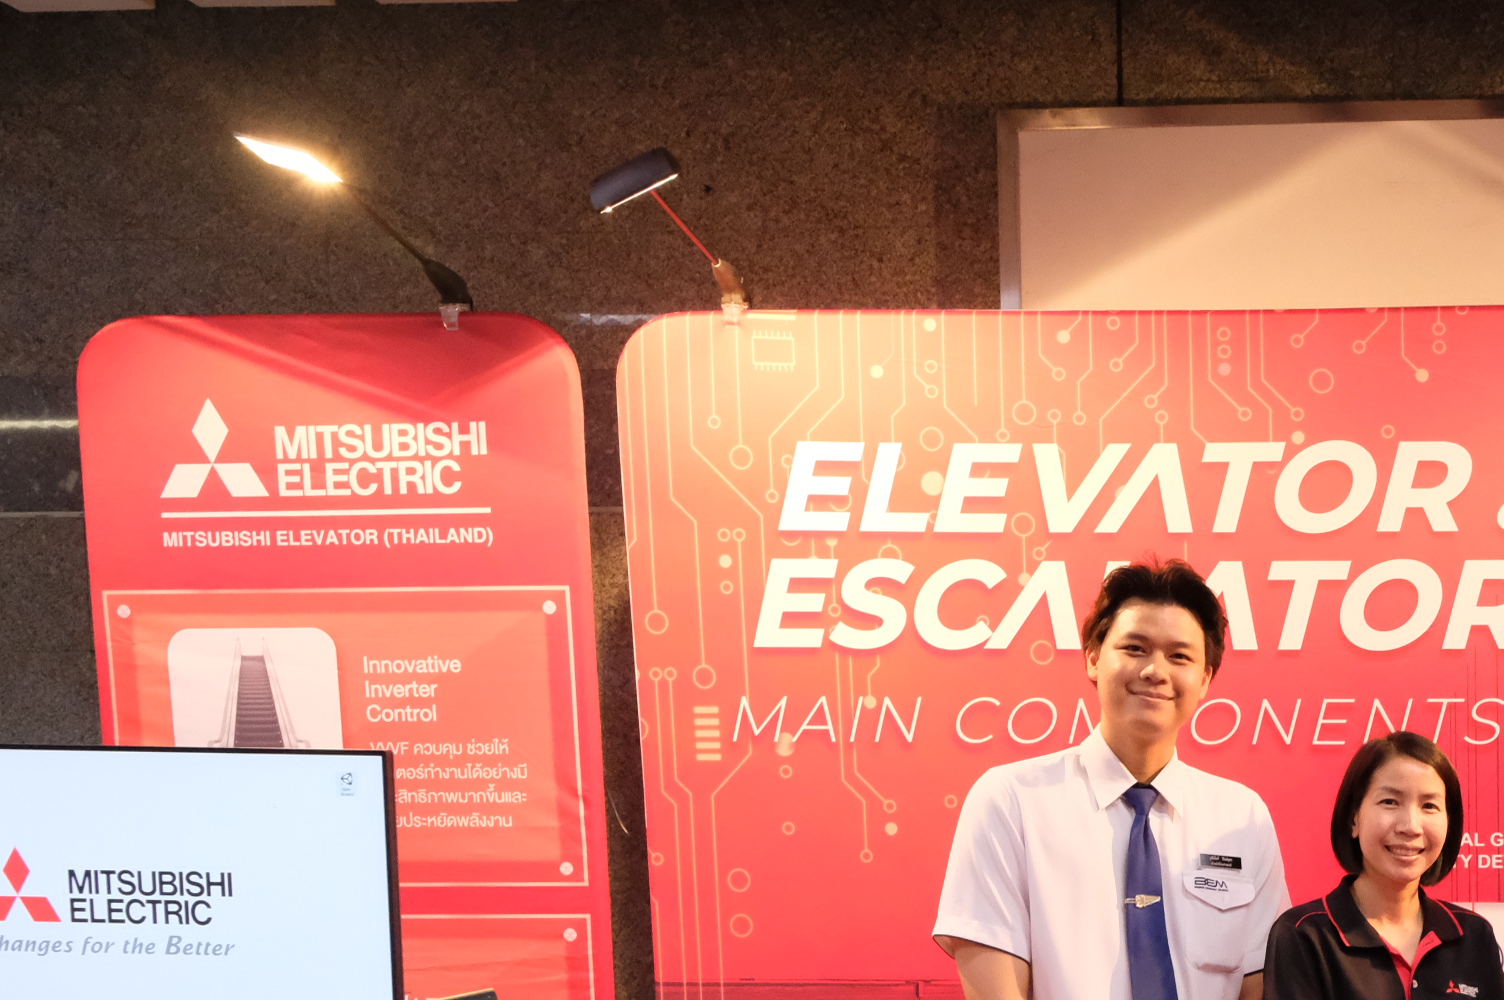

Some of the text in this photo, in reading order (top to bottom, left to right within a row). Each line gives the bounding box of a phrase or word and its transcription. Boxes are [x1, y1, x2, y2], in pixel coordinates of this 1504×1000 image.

[274, 421, 488, 459] MITSUBISHI
[278, 460, 462, 497] ELECTRIC
[776, 439, 1474, 534] ELEVATOR
[163, 526, 493, 548] MITSUBISHI ELEVATOR (THAILAND)
[363, 655, 462, 673] Innovative
[365, 681, 438, 698] Inverter
[366, 704, 437, 723] Control
[732, 695, 923, 745] MAIN
[414, 743, 462, 759] ควบคุม
[466, 738, 509, 755] ช่วยให้
[396, 763, 528, 779] ตอร์ทำงานได้อย่างมี
[395, 784, 527, 803] ะสิทธิภาพมากขึ้นและ
[396, 812, 513, 828] ยประหยัดพลังงาน
[68, 869, 233, 897] MITSUBISHI
[70, 898, 212, 926] ELECTRIC
[0, 935, 235, 956] hanges for the Better
